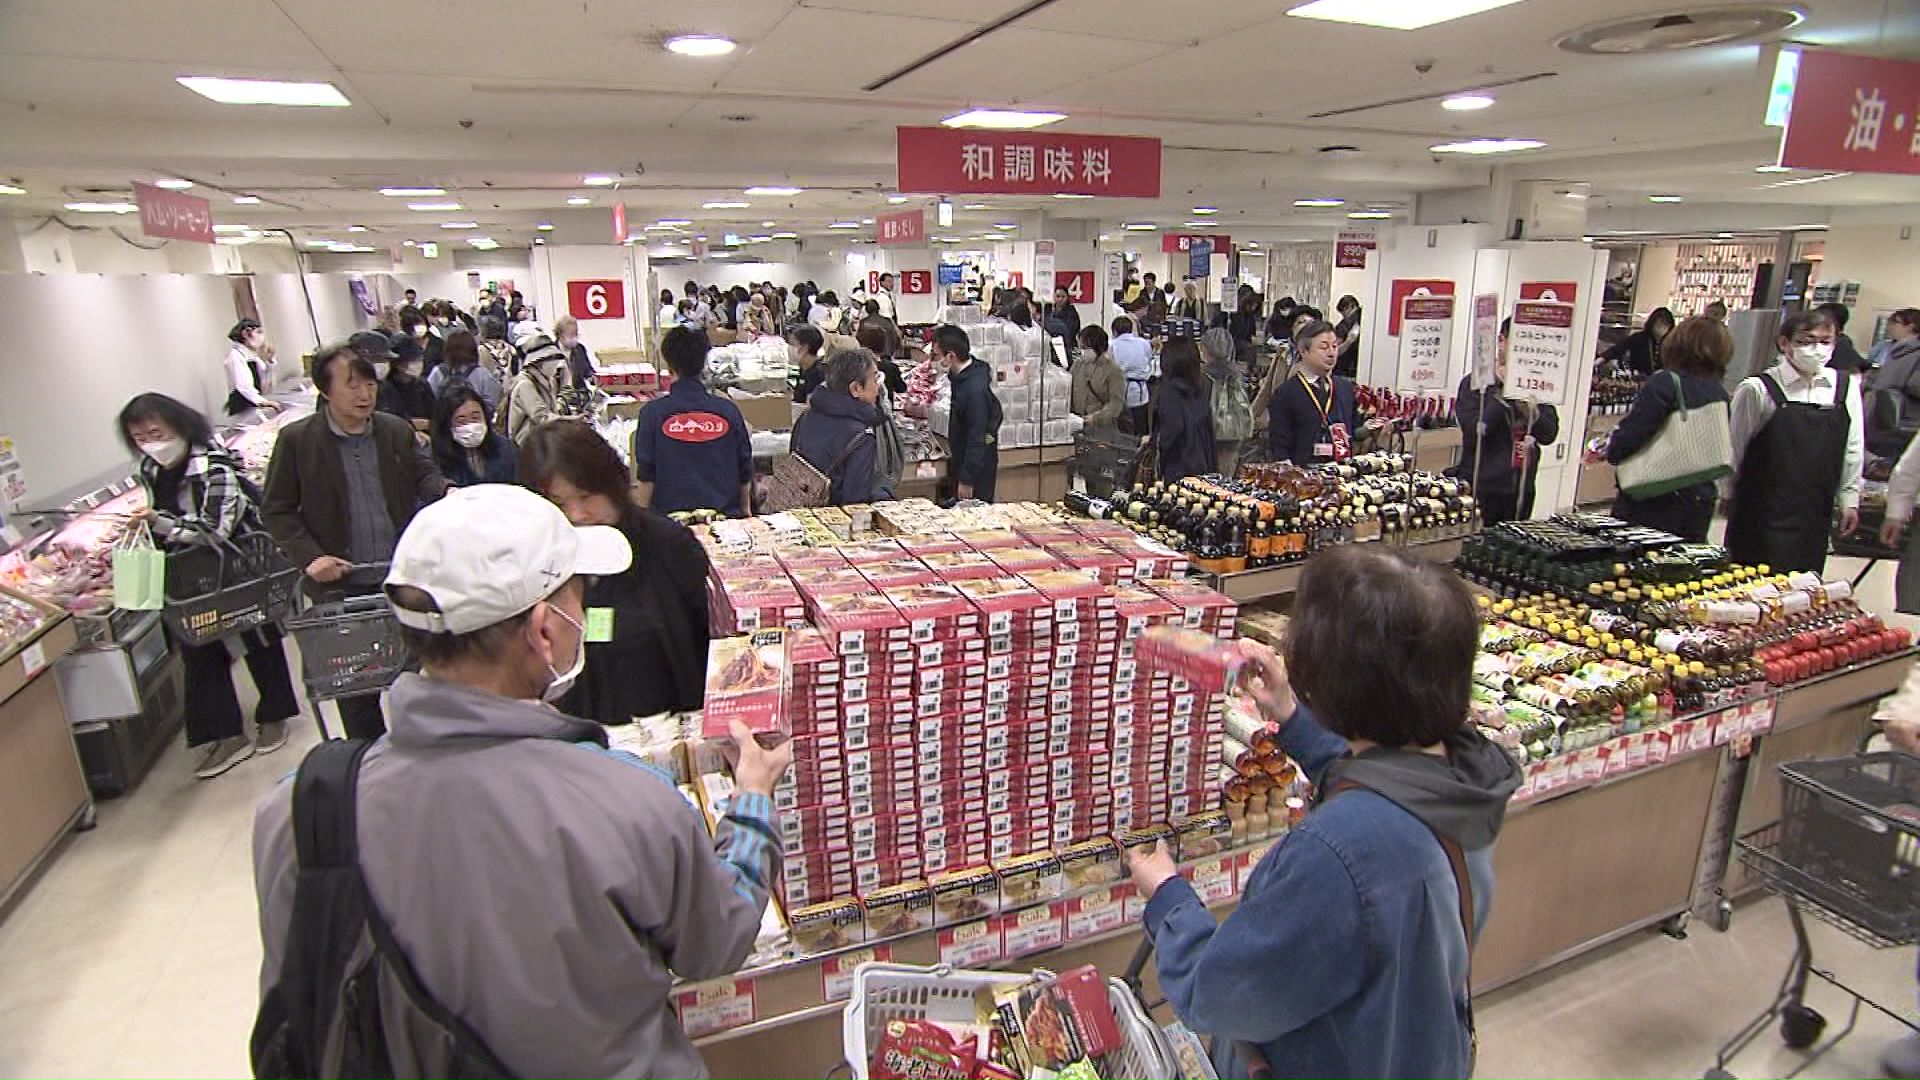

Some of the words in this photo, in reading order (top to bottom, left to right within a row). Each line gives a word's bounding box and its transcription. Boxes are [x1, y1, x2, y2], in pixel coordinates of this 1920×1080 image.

[962, 143, 1112, 185] 和調味料
[146, 202, 209, 235] ハム・ソーセージ
[911, 272, 923, 292] 5
[1068, 275, 1083, 300] 4
[586, 284, 608, 315] 6
